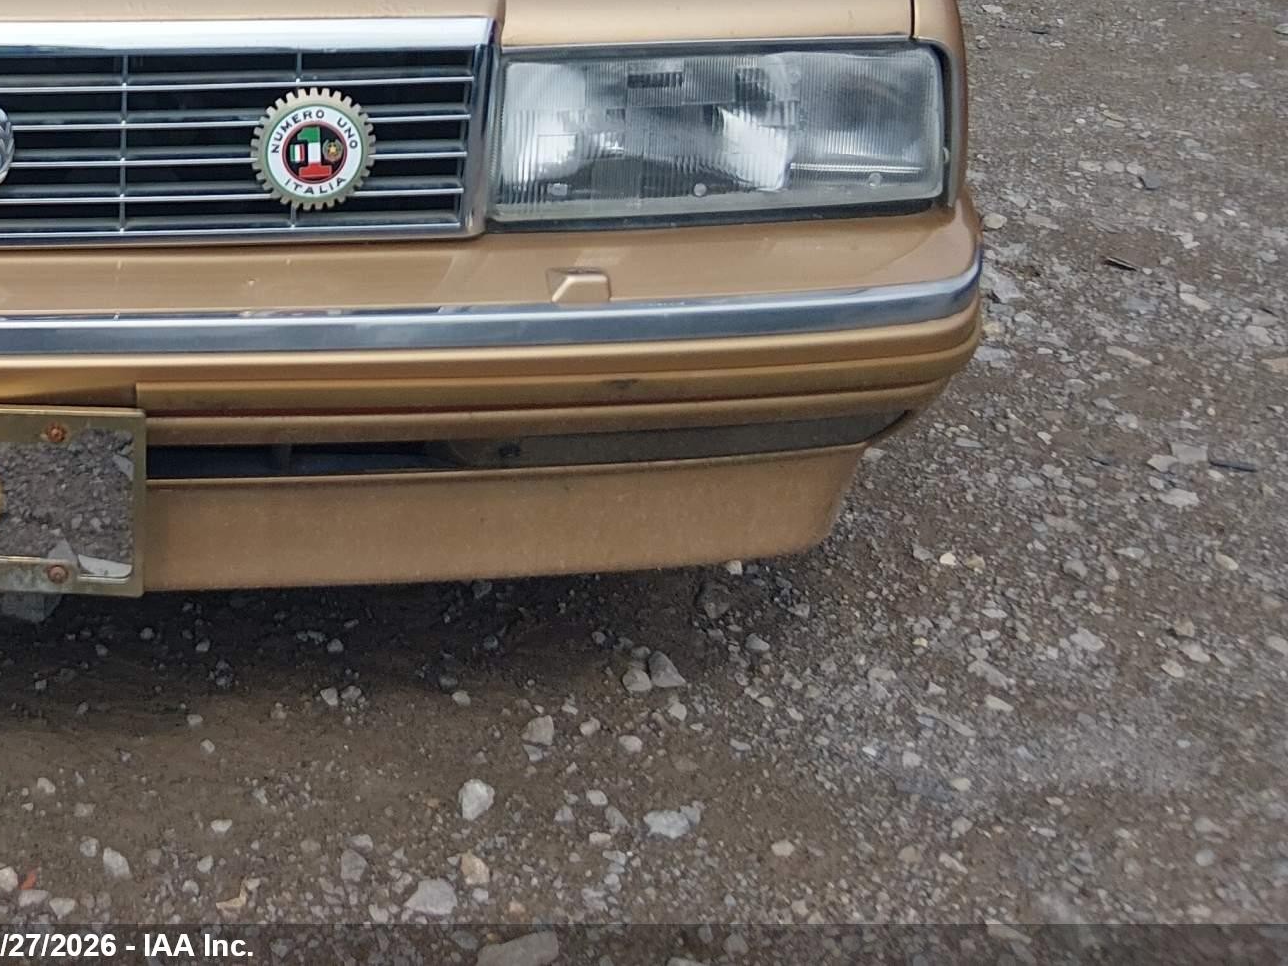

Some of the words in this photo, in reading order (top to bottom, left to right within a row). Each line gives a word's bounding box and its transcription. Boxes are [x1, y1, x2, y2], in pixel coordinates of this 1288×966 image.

[271, 109, 325, 154] NUMERO
[336, 117, 359, 149] UNO
[284, 177, 347, 195] ITALIA
